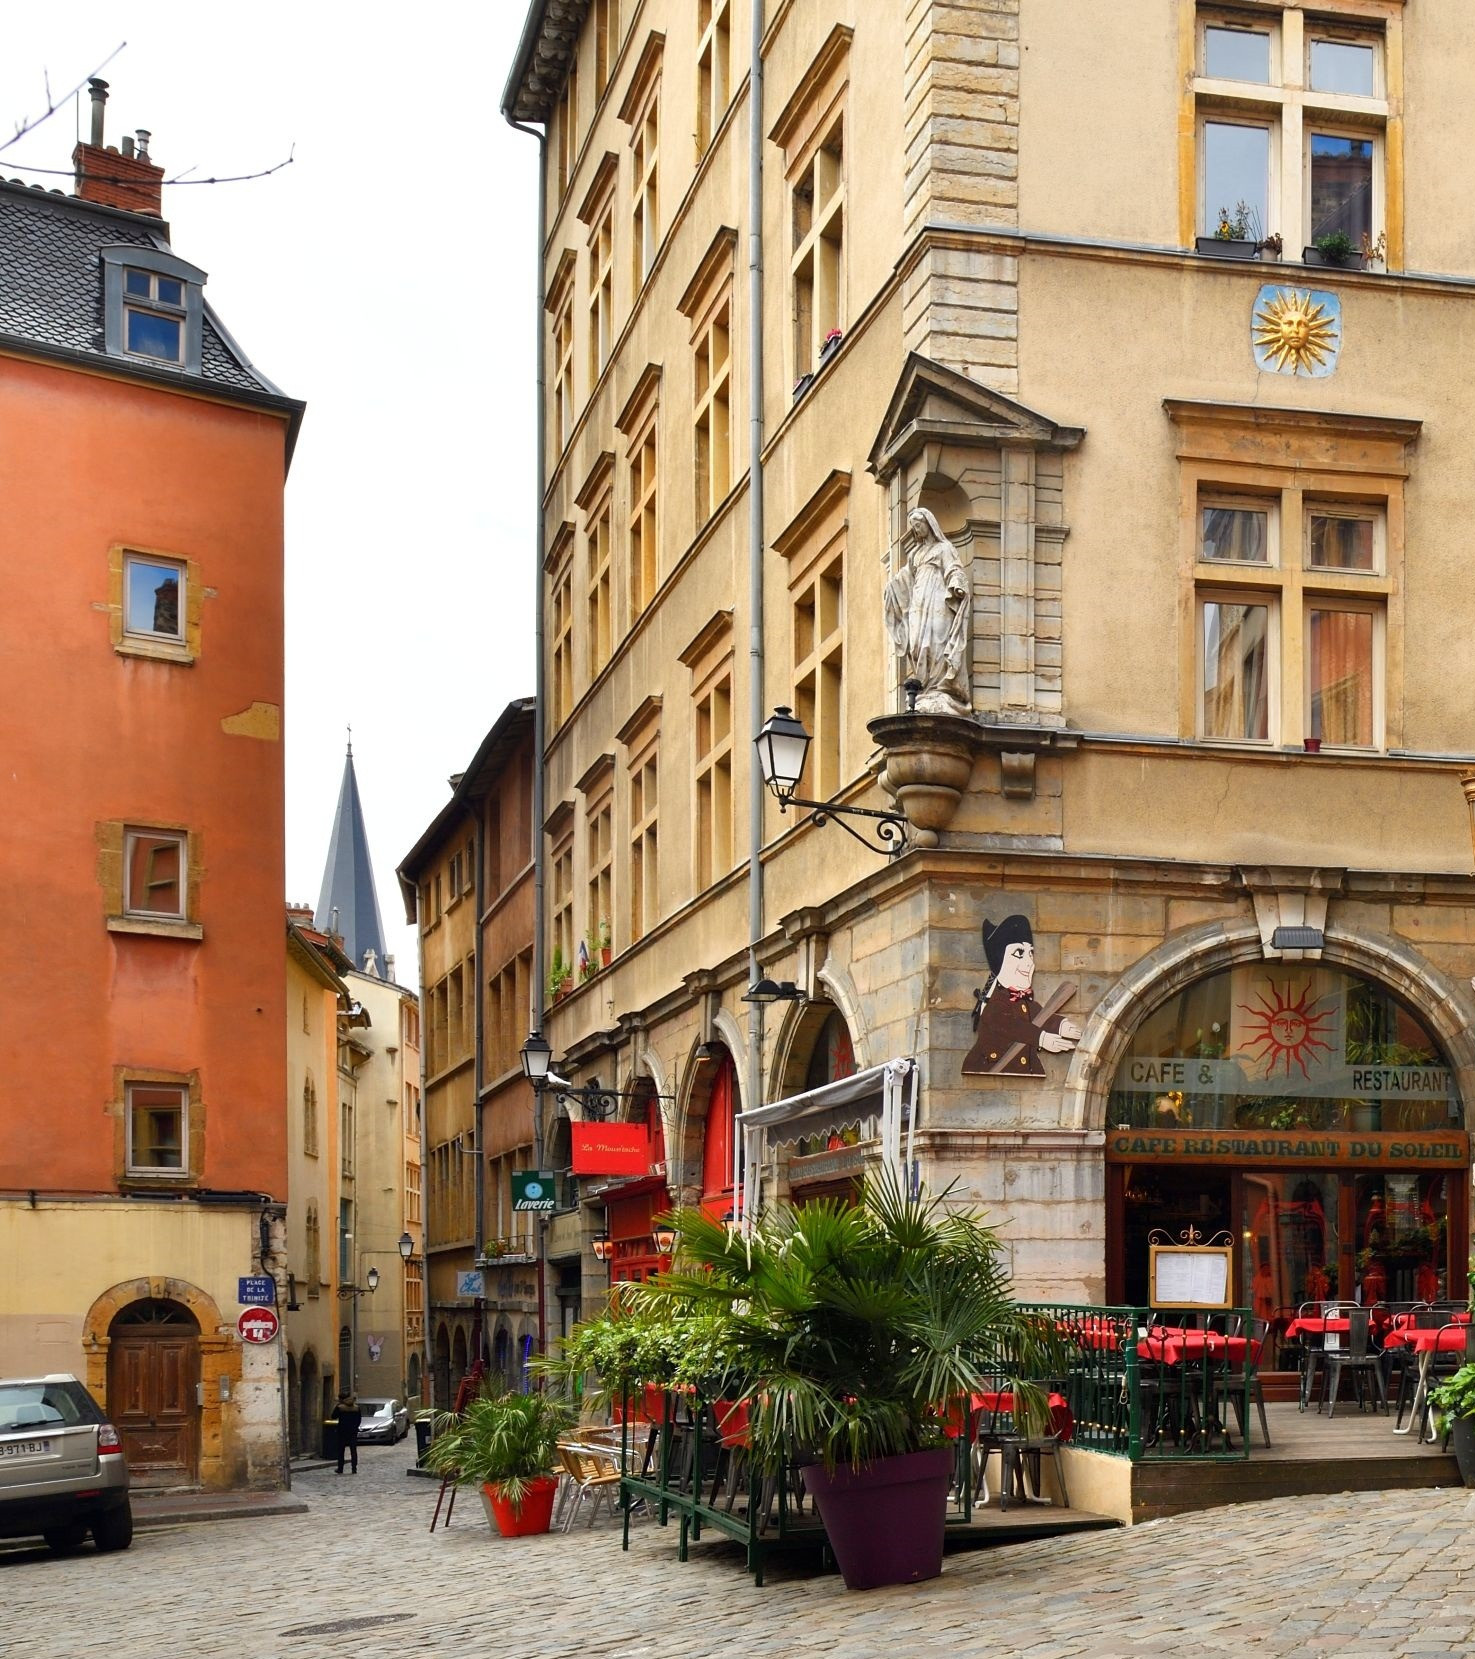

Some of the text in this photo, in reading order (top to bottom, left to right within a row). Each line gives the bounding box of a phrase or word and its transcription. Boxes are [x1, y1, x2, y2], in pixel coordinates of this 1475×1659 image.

[1130, 1061, 1214, 1085] CAFE &
[1353, 1070, 1451, 1092] RESTAURANT
[1113, 1136, 1463, 1159] CAFE RESTAURANT DU SOLEIL
[514, 1197, 555, 1211] Laverie
